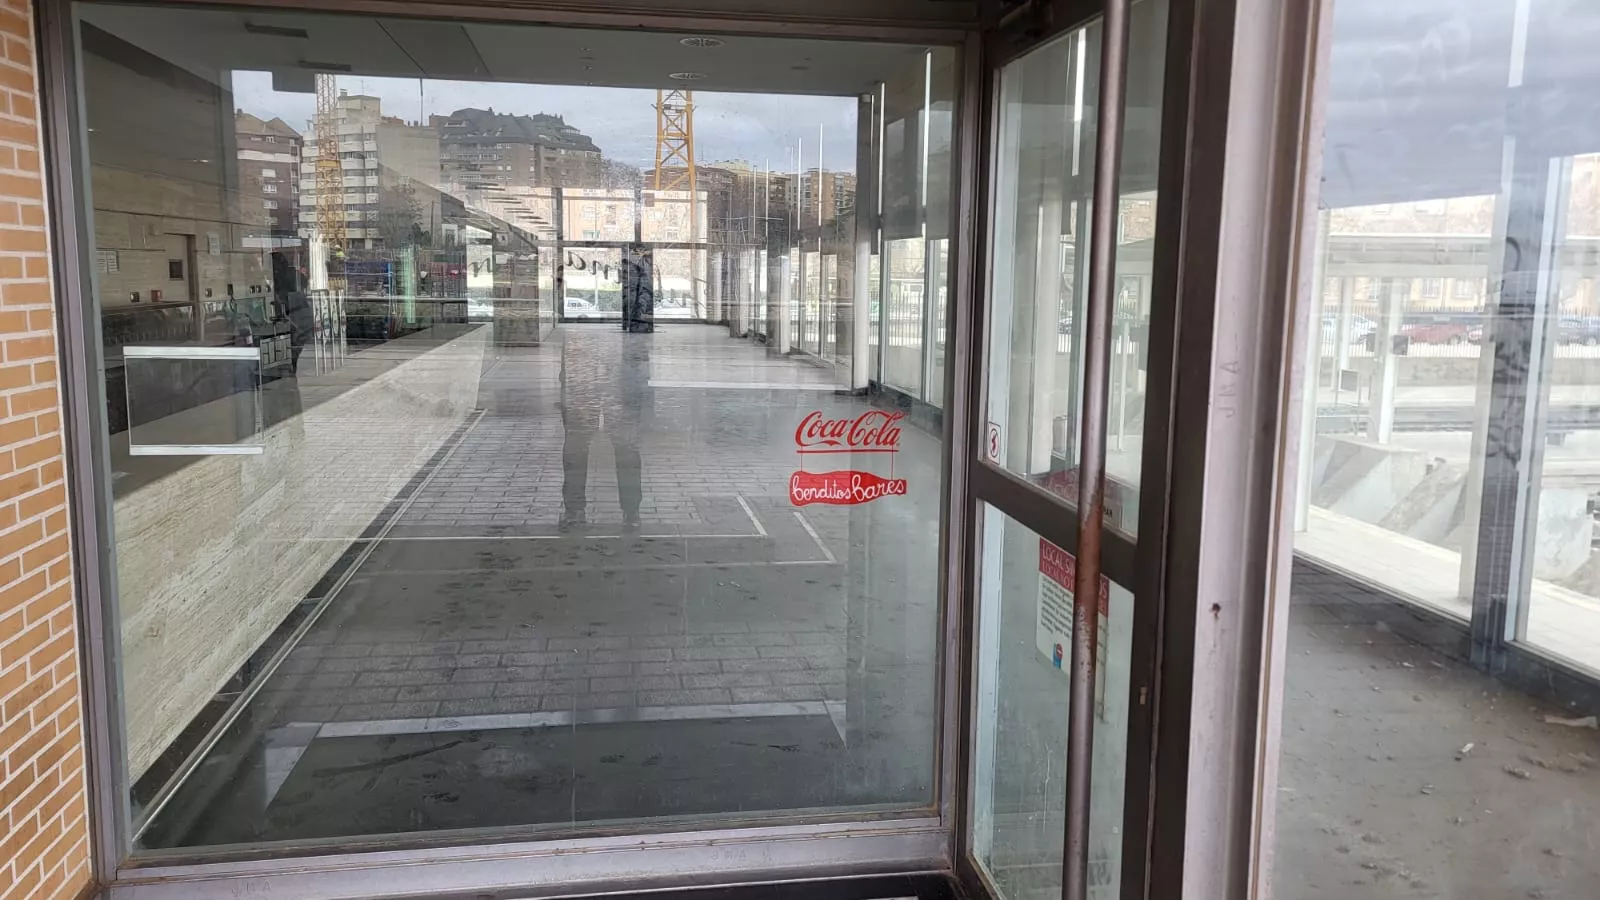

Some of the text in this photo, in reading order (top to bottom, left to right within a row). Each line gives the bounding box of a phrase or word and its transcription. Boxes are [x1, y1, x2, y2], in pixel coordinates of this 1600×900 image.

[795, 410, 908, 447] Coca-Cola
[792, 475, 850, 501] benditos
[1042, 543, 1064, 570] LOCAL
